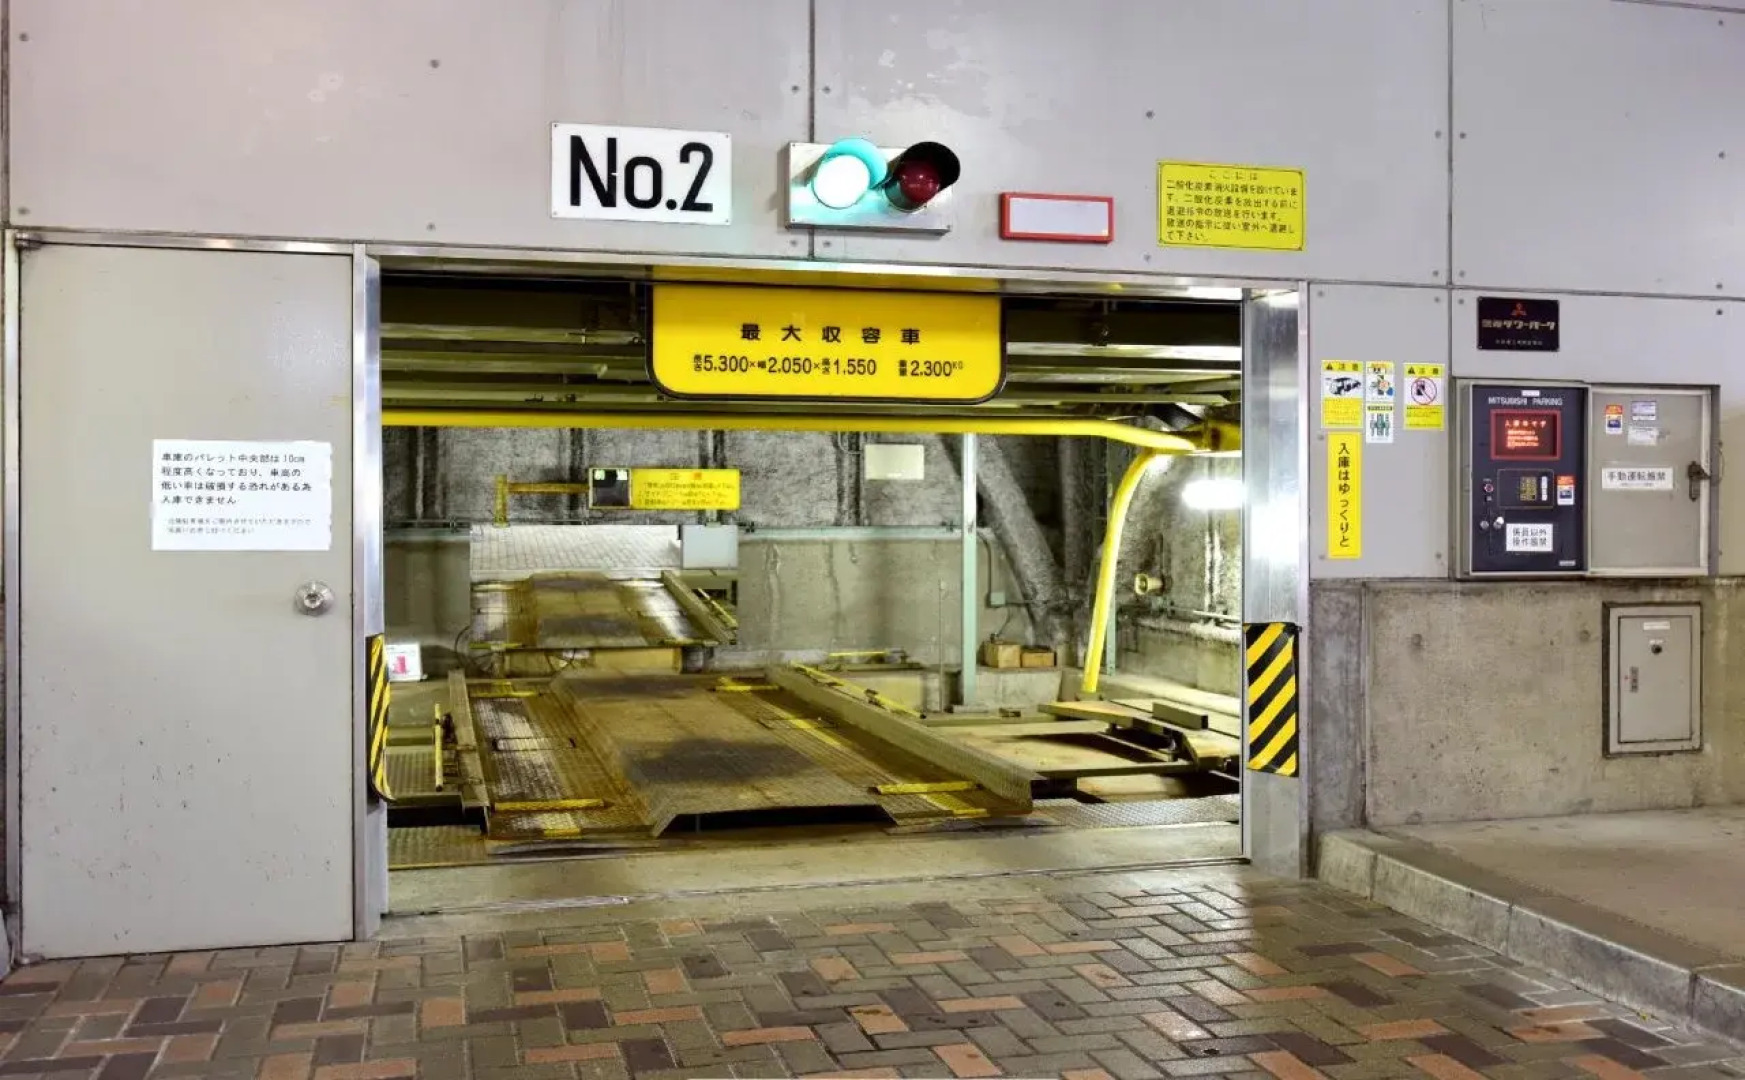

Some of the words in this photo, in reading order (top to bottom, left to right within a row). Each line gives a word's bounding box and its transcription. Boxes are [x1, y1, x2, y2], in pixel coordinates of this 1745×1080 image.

[570, 135, 713, 212] No.2
[741, 323, 920, 345] 最大収容車
[1488, 397, 1528, 405] MITSUBISHI
[1532, 397, 1563, 406] PARKING
[161, 481, 313, 492] 低い車は破損する恐れがある為
[161, 495, 237, 505] 入庫できません
[1338, 442, 1351, 548] 入庫はゆっくりと
